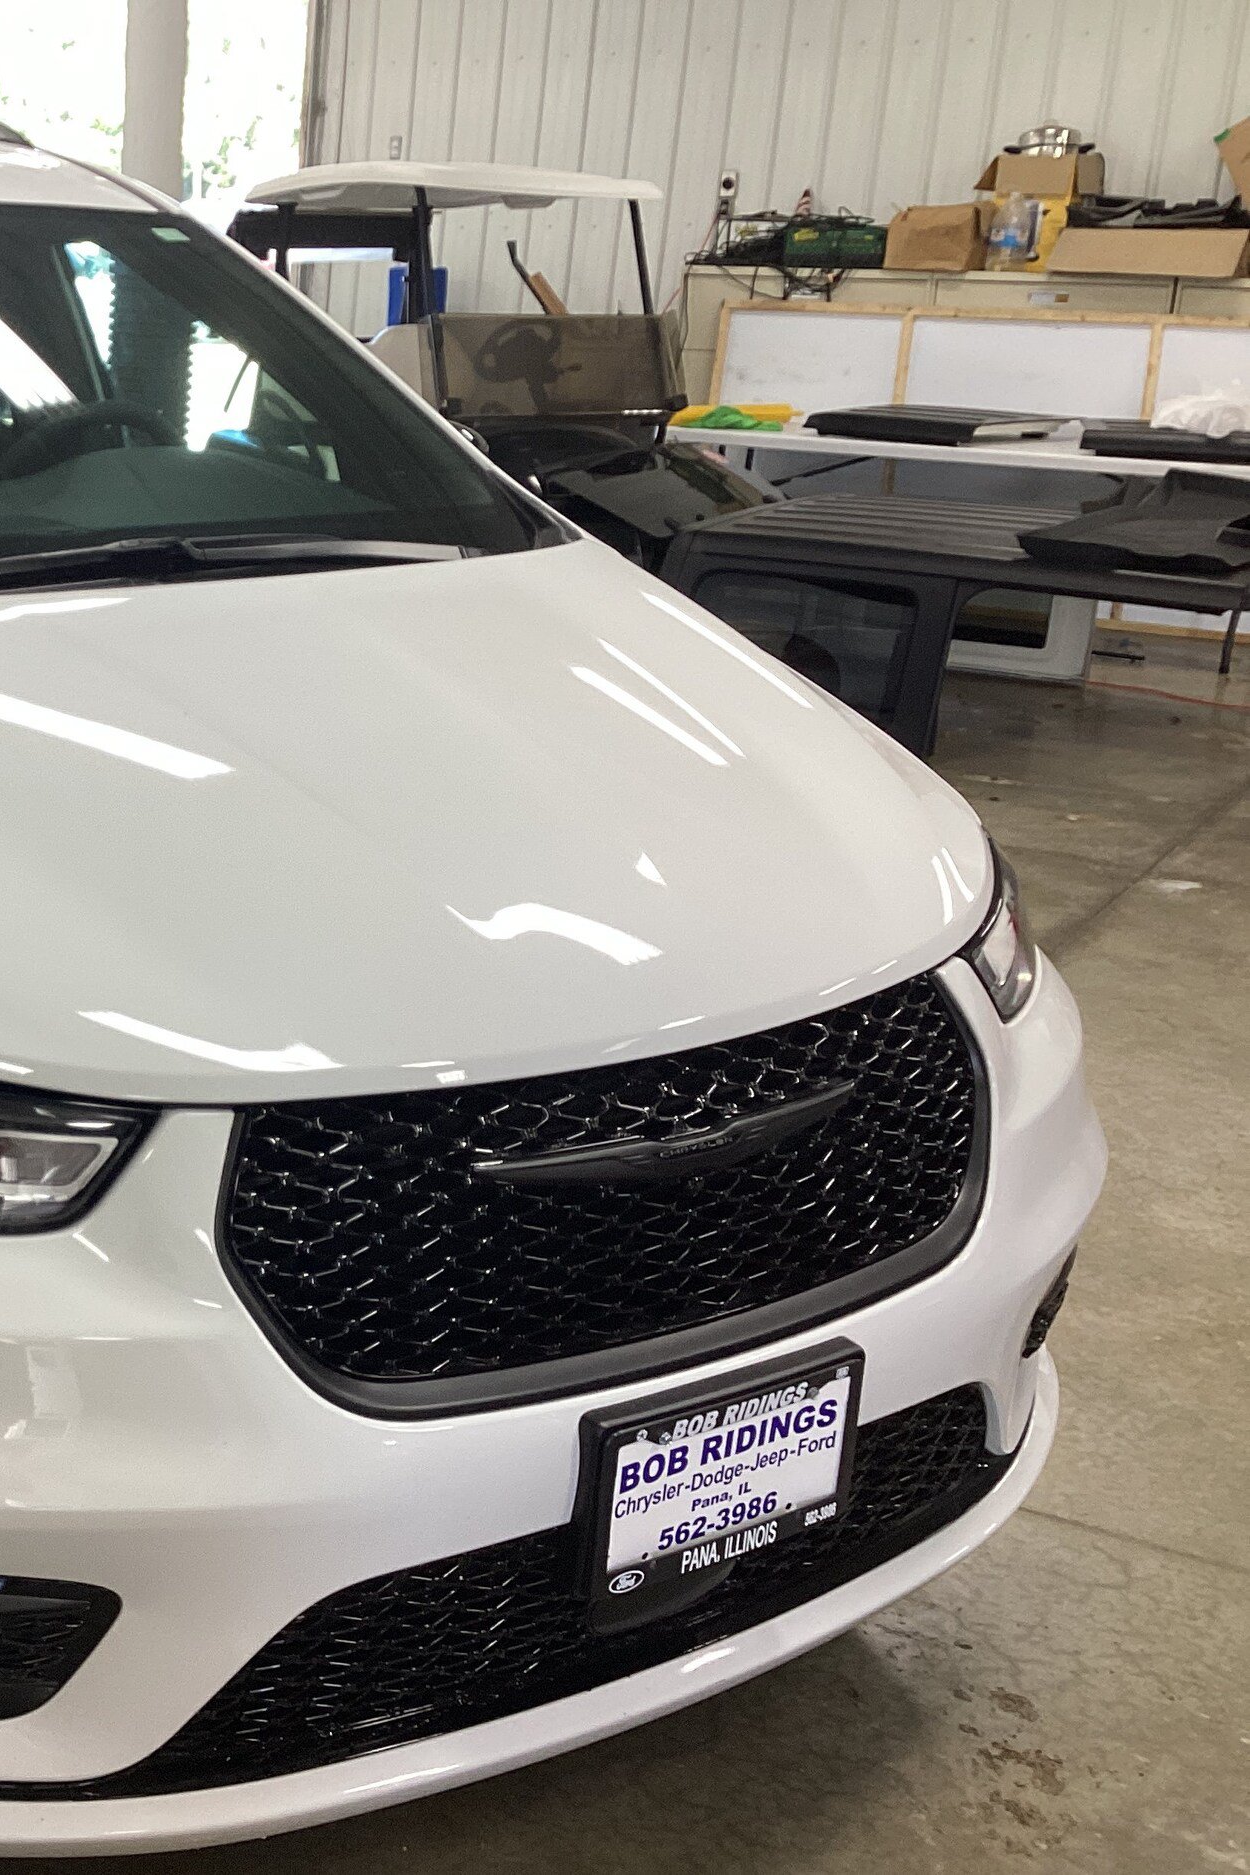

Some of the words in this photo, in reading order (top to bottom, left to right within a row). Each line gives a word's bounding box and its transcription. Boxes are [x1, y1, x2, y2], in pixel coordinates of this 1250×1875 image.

[672, 1410, 718, 1441] BOB
[723, 1382, 809, 1426] RIDINGS
[615, 1431, 836, 1519] Chrysler-Dodge-Jeep-Ford
[619, 1445, 688, 1494] BOB
[700, 1400, 837, 1466] RIDINGS
[658, 1491, 777, 1550] 562-3986
[691, 1491, 732, 1511] Pana,
[739, 1482, 751, 1495] IL
[724, 1521, 778, 1560] ILLINOIS
